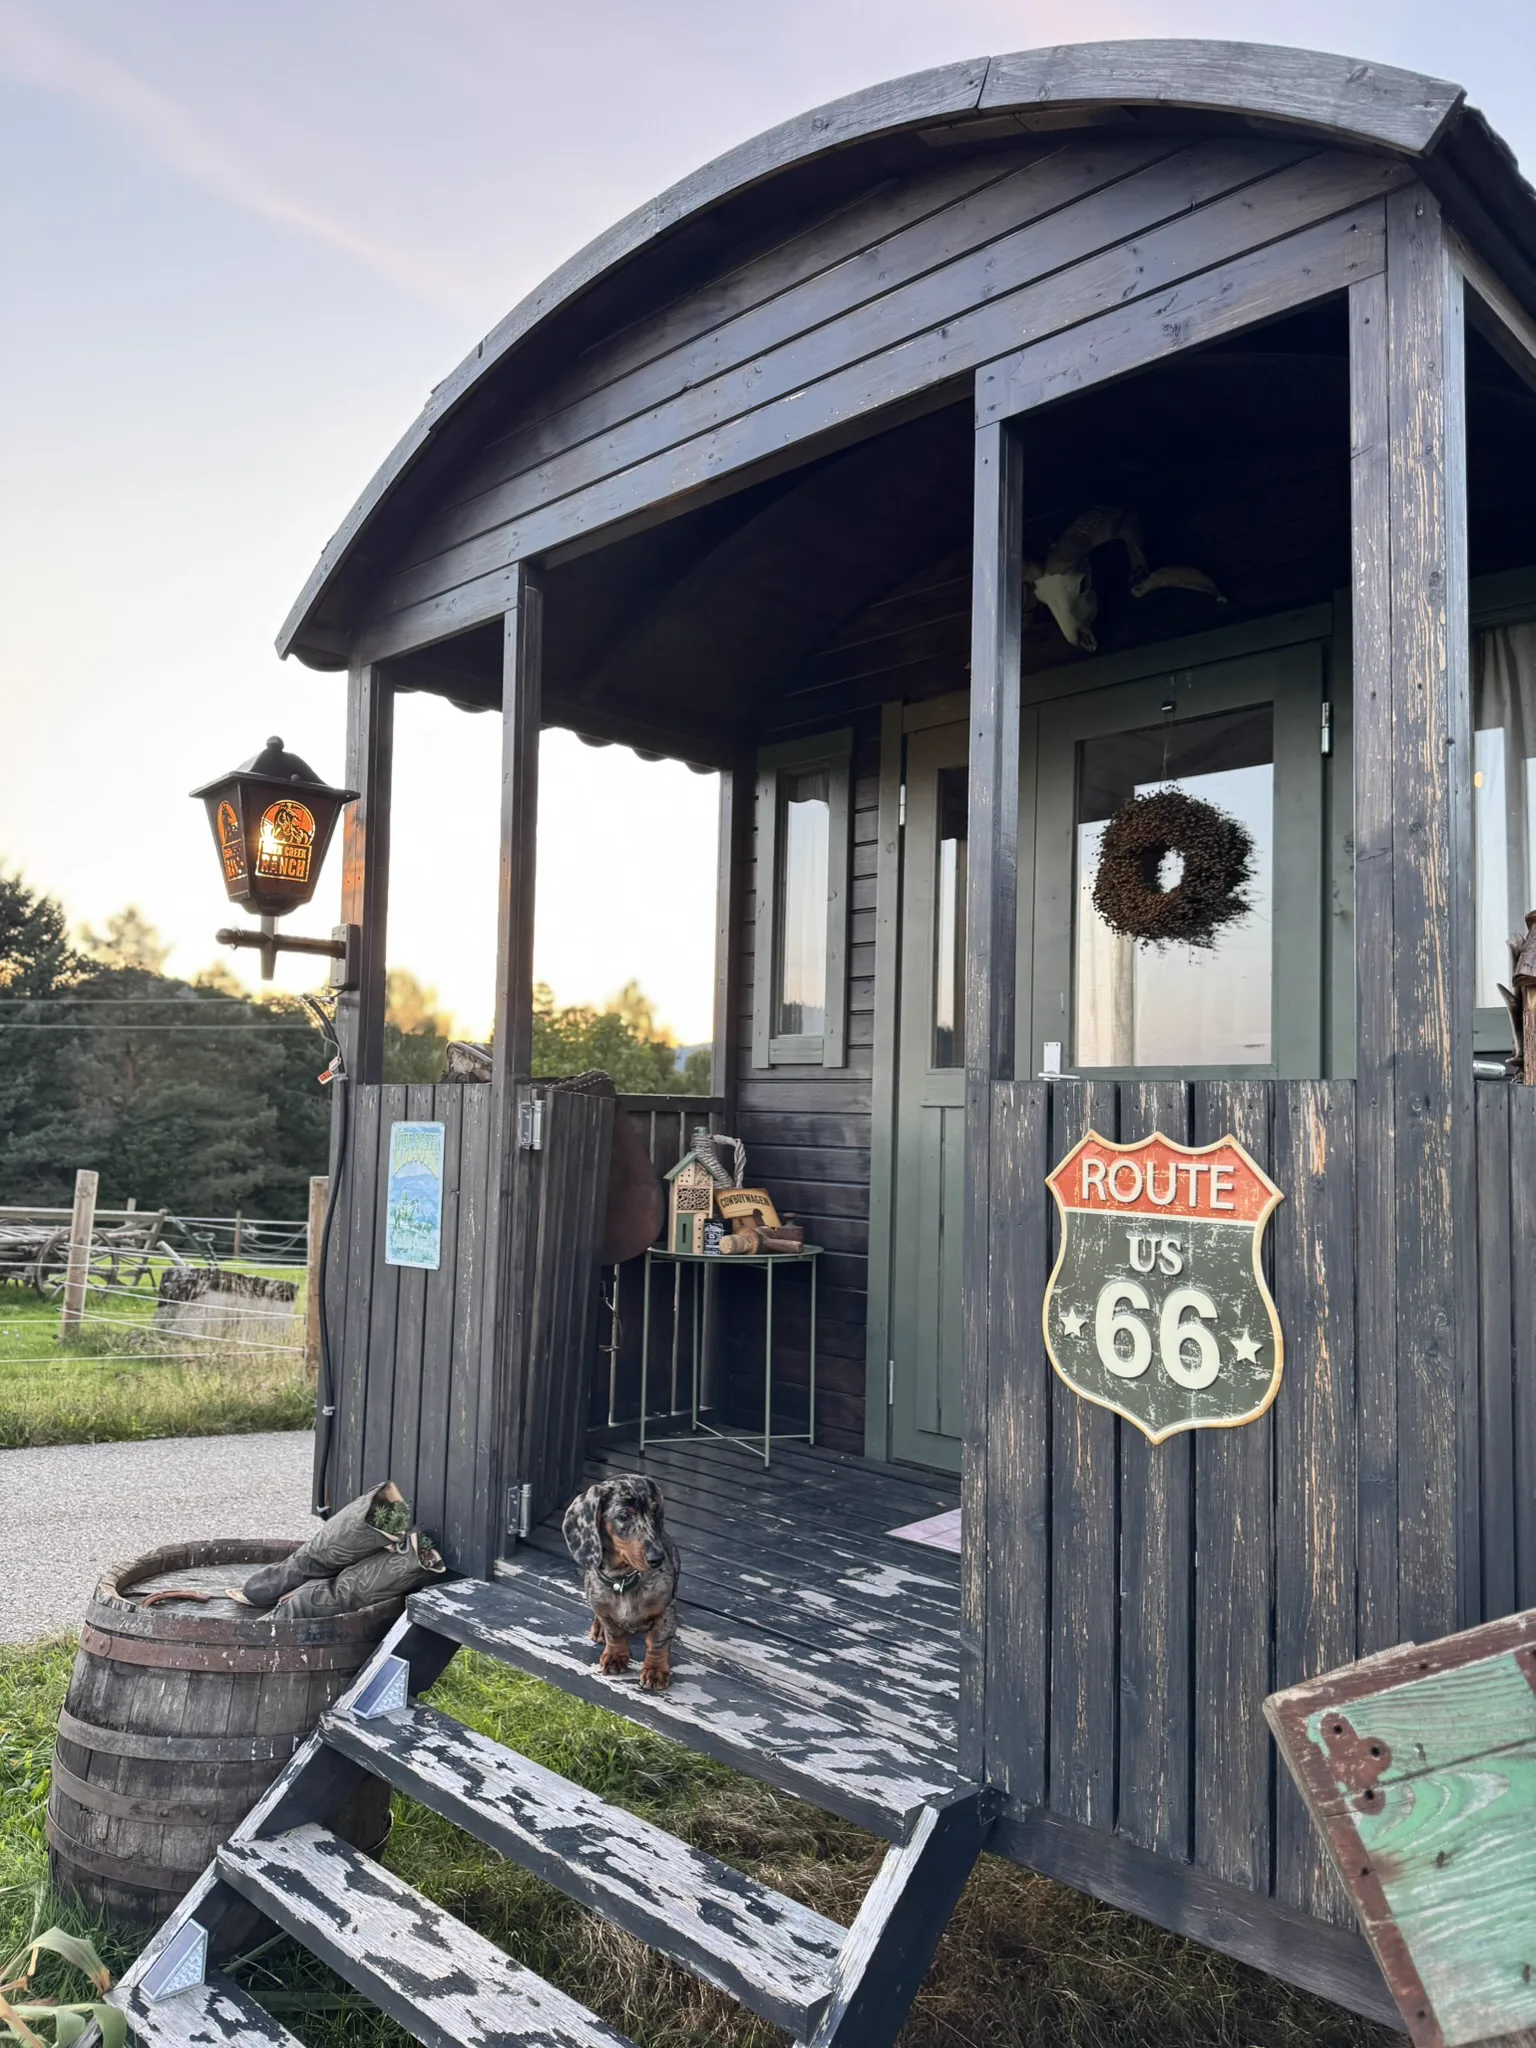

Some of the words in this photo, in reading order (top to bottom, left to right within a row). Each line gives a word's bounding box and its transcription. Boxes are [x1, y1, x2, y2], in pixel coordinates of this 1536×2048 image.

[261, 854, 306, 877] RANCH
[284, 846, 306, 859] CREEK
[1082, 1158, 1235, 1210] ROUTE
[720, 1194, 770, 1208] COWBOYWAGEN
[1126, 1232, 1184, 1276] US
[1095, 1279, 1220, 1390] 66
